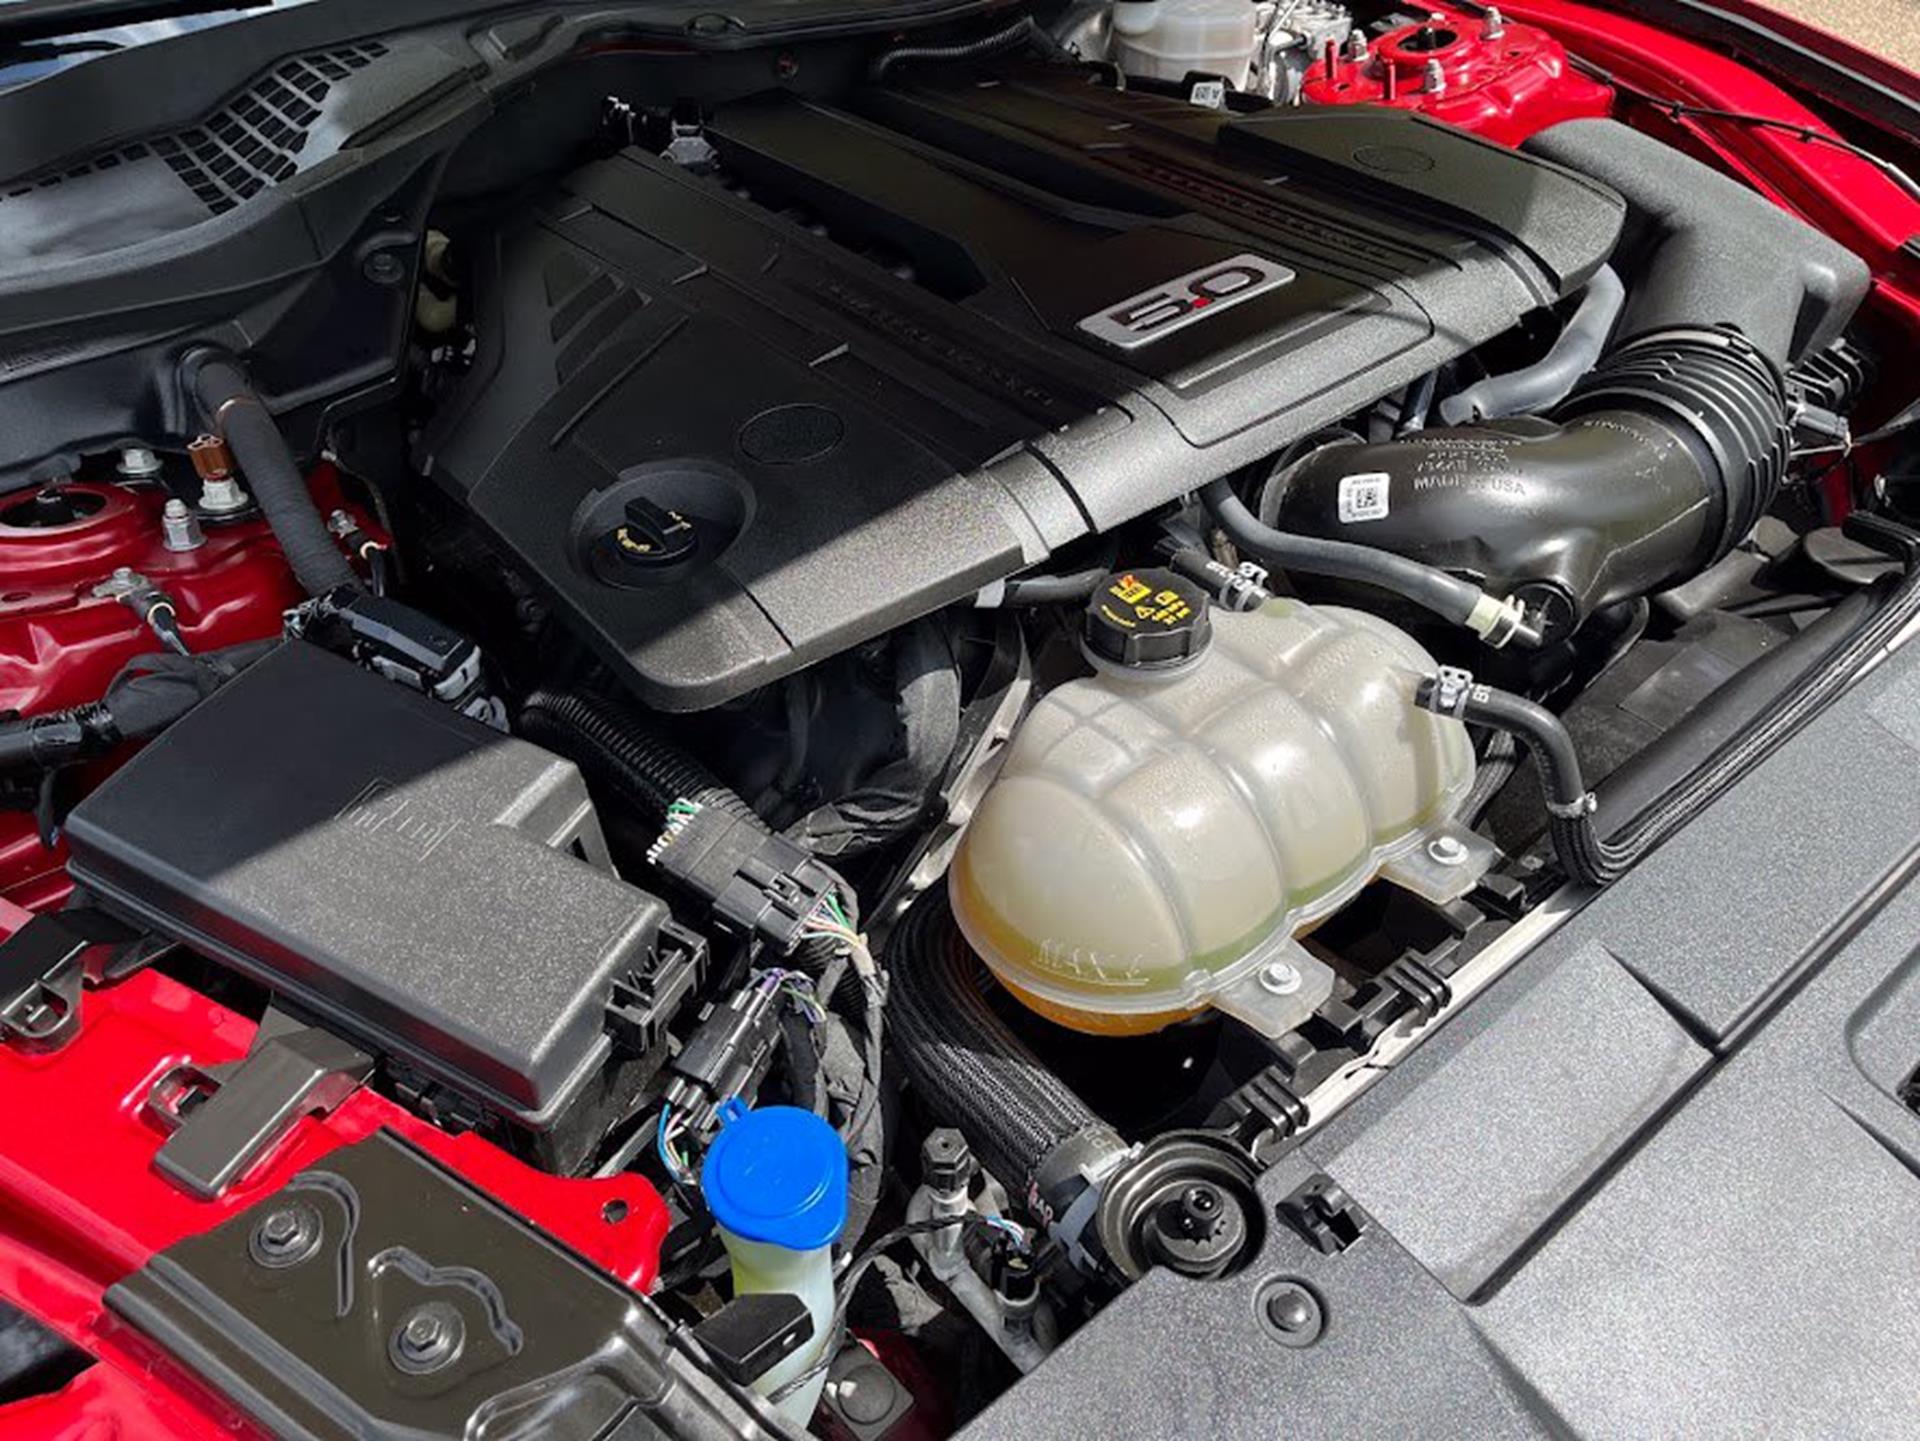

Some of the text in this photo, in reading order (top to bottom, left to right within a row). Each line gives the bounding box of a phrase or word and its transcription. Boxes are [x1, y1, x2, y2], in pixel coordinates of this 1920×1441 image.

[1109, 265, 1266, 333] 5.0
[1413, 475, 1466, 491] MADE
[1491, 477, 1527, 496] USA
